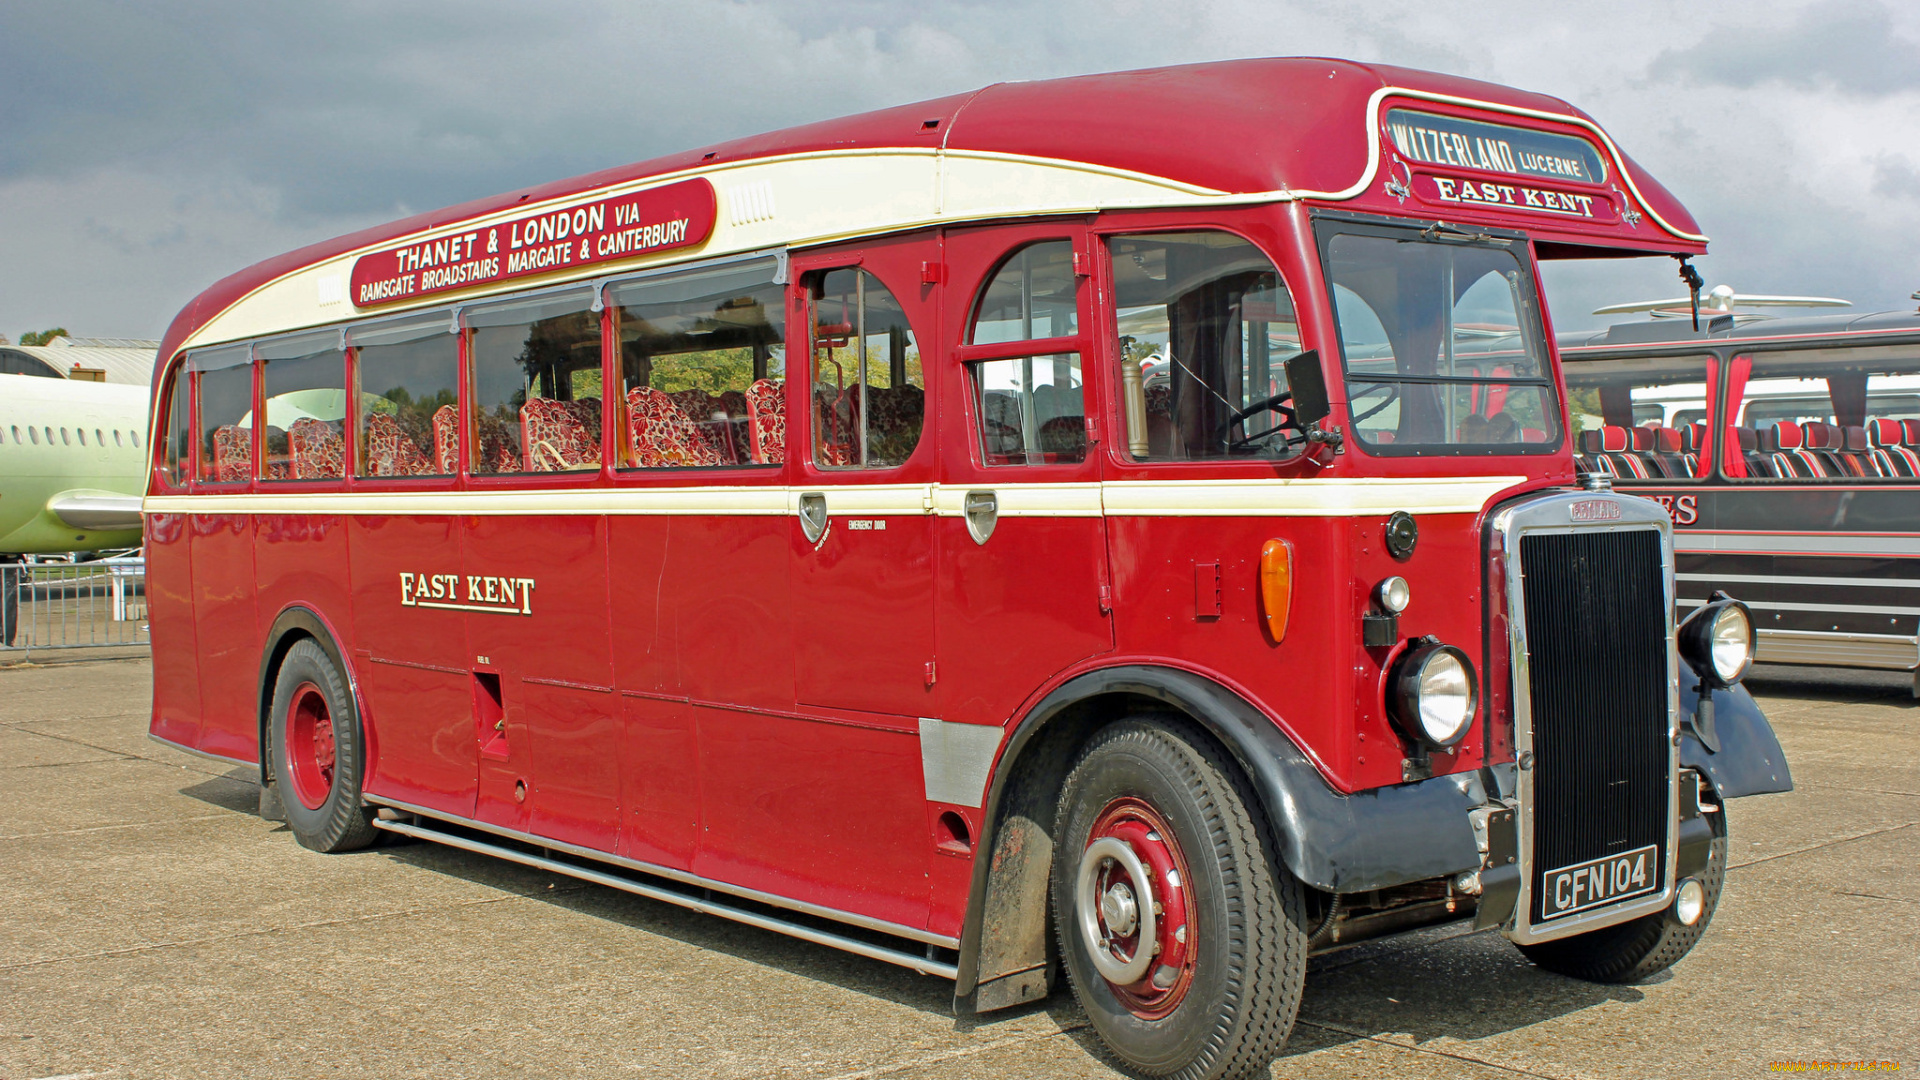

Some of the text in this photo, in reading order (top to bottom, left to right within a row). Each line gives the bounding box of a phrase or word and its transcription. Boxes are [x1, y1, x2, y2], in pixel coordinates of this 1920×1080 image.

[1387, 123, 1583, 178] WITZERLAND LUCERNE
[1433, 177, 1596, 218] EAST KENT
[360, 218, 689, 303] RAMSGATE BROADSTAIRS MARGATE & CANTERBURY
[396, 202, 641, 273] THANET & LONDON VIA
[848, 520, 886, 531] EMERGENCY DOOR
[399, 572, 535, 615] EAST KENT
